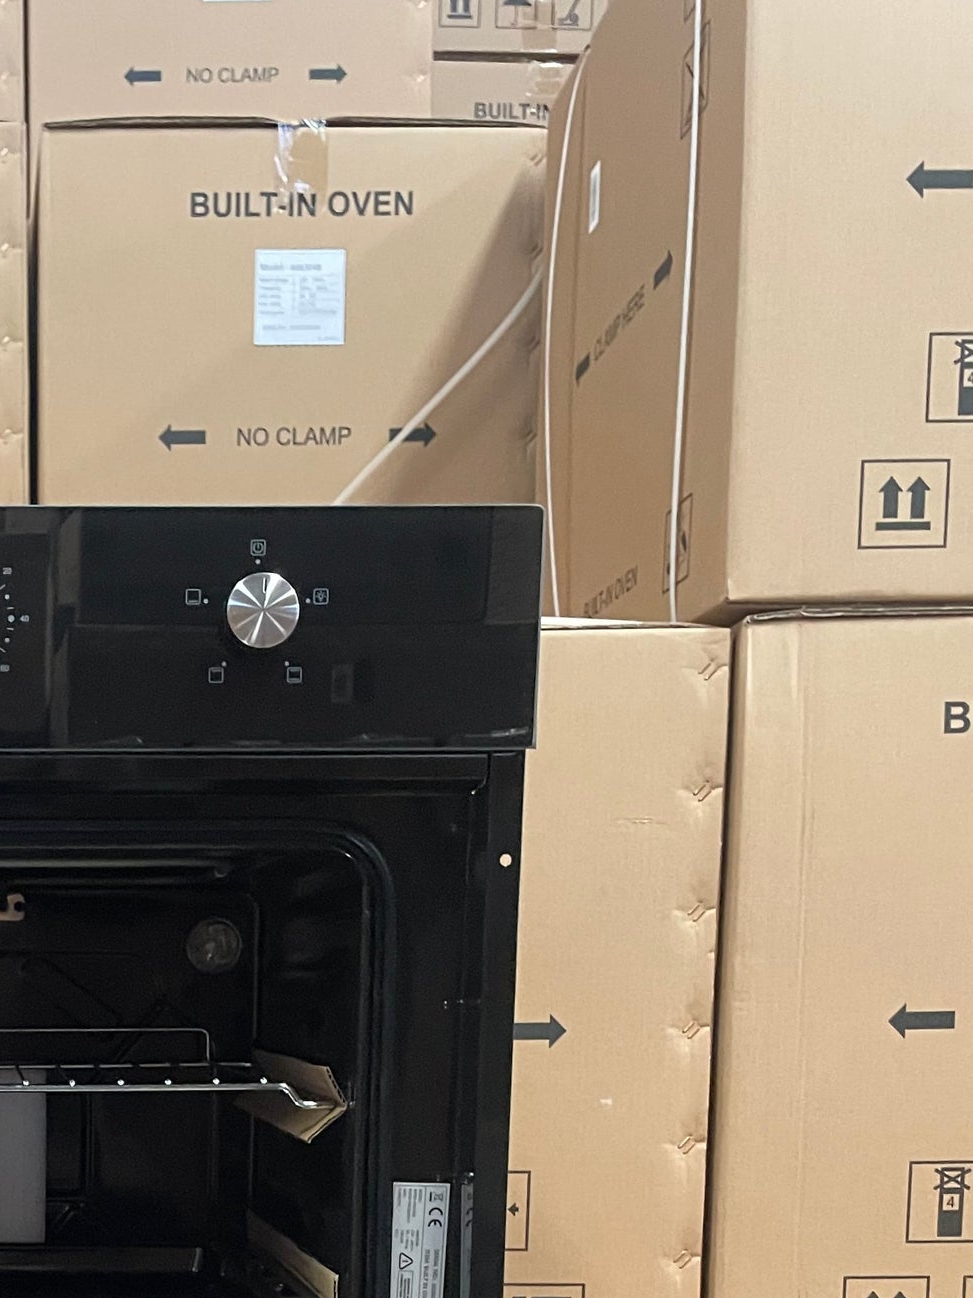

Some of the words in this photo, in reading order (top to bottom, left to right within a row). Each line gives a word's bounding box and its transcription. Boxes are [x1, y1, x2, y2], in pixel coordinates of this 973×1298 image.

[186, 67, 213, 84] NO
[217, 67, 280, 83] CLAMP
[190, 192, 317, 217] BUILT-IN
[328, 191, 414, 216] OVEN
[237, 427, 270, 446] NO
[276, 427, 352, 446] CLAMP
